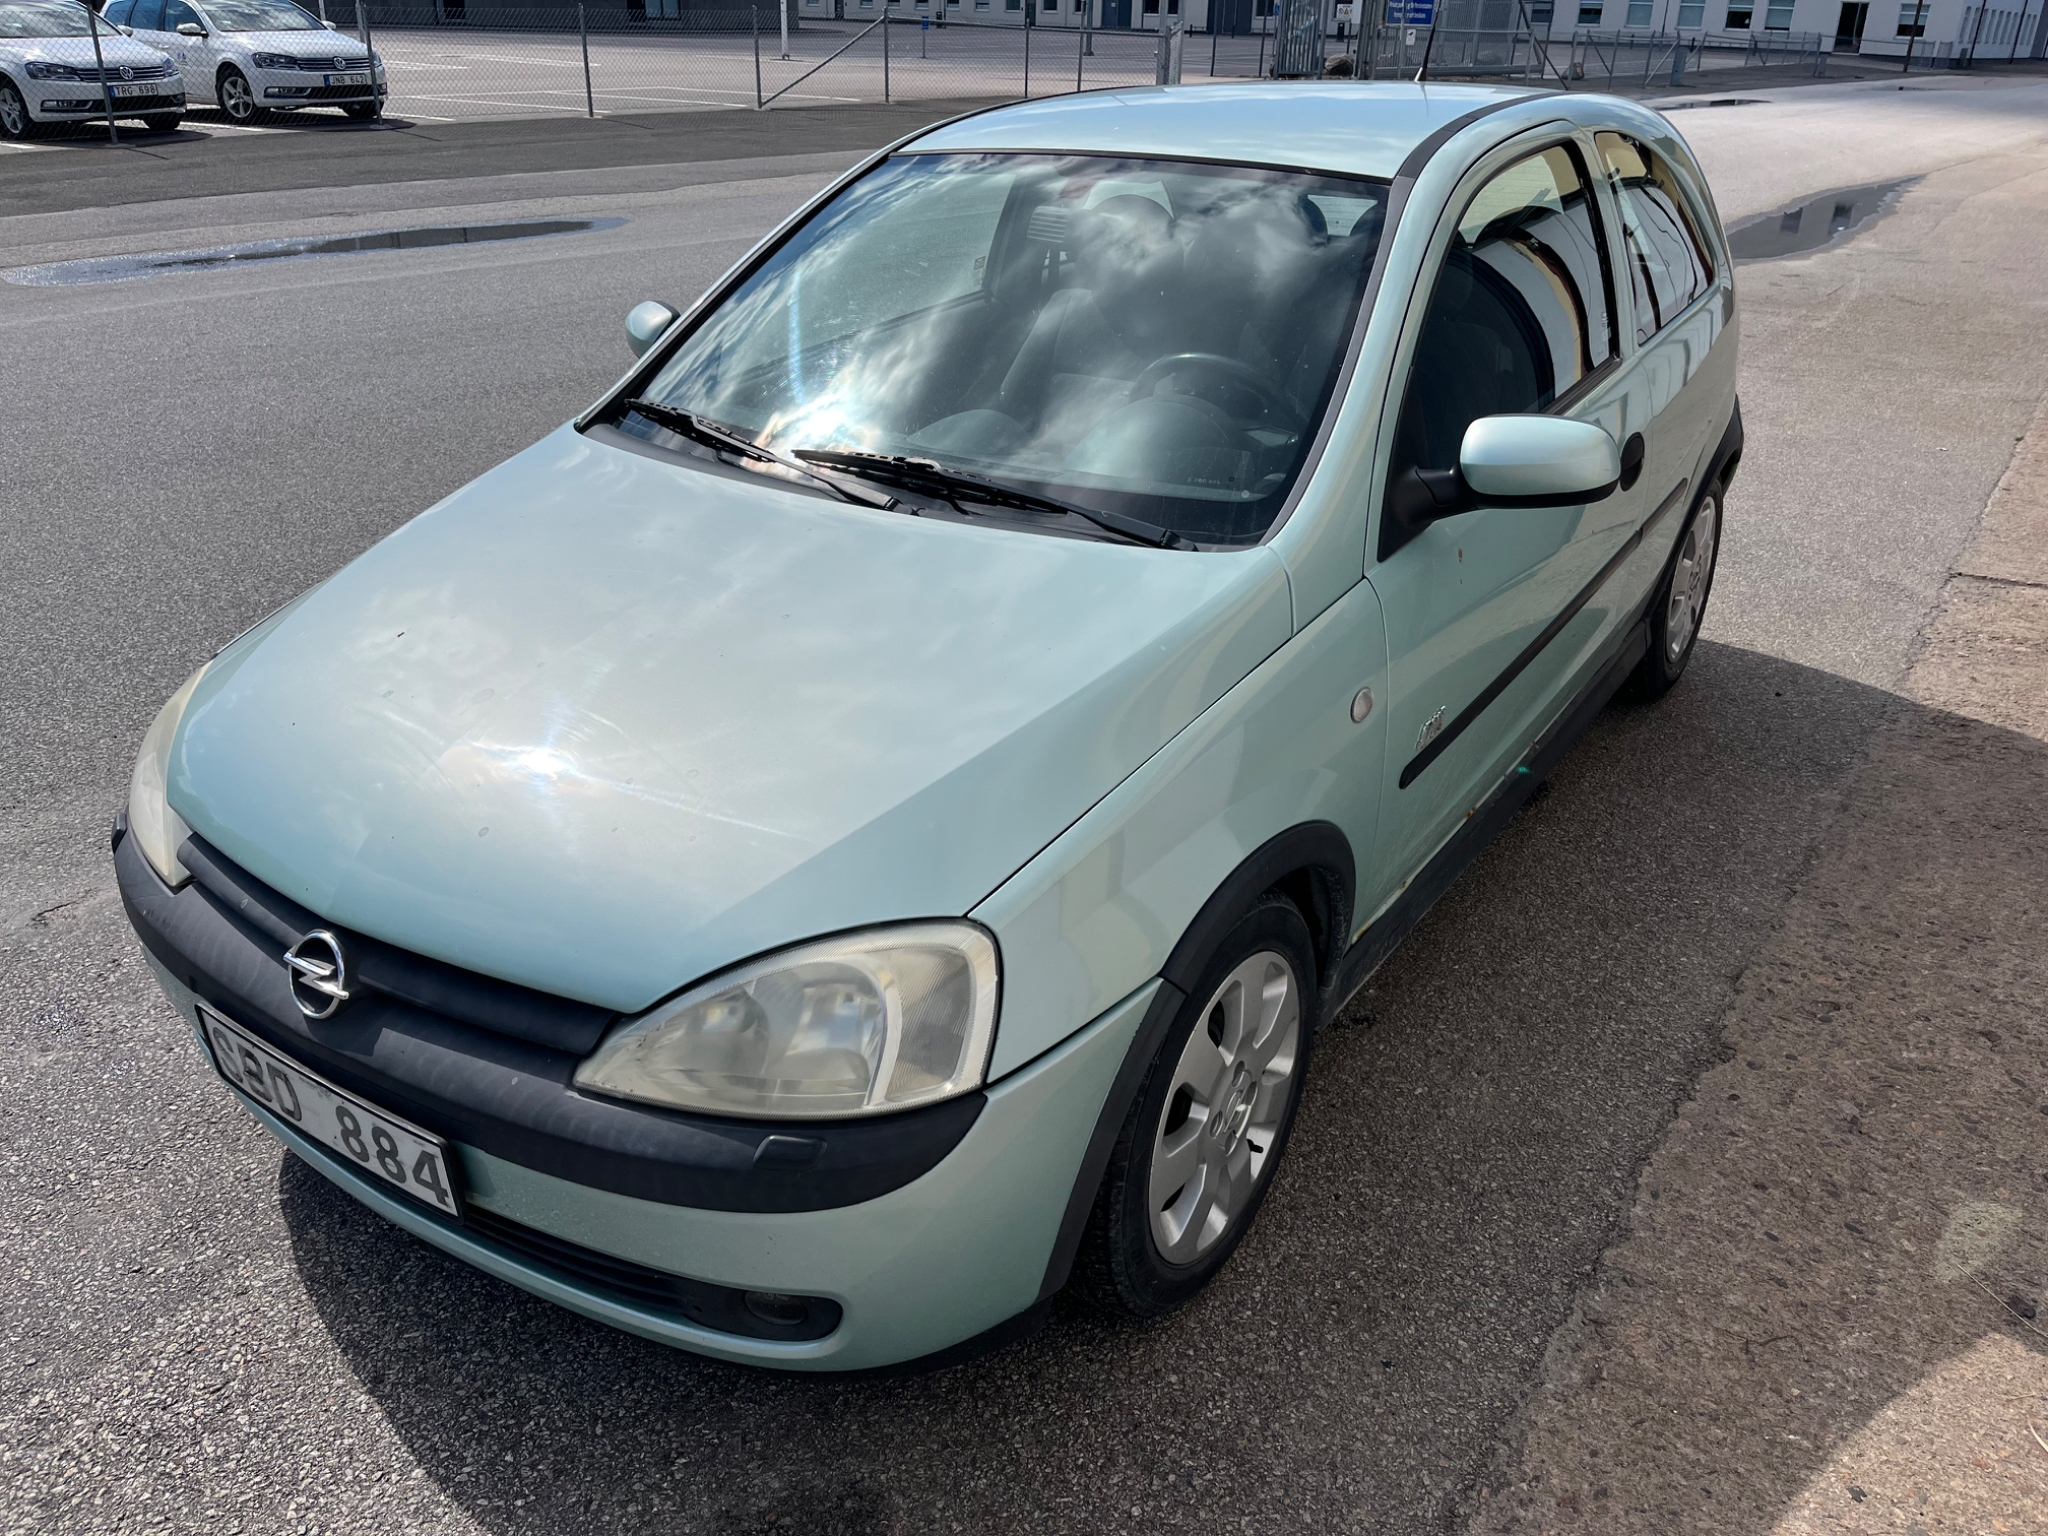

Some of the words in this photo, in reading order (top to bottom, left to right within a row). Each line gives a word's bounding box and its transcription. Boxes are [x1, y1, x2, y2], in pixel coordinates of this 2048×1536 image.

[115, 85, 133, 96] TRG
[138, 83, 156, 94] 698
[212, 1026, 303, 1122] SBD
[335, 1105, 449, 1207] 884
